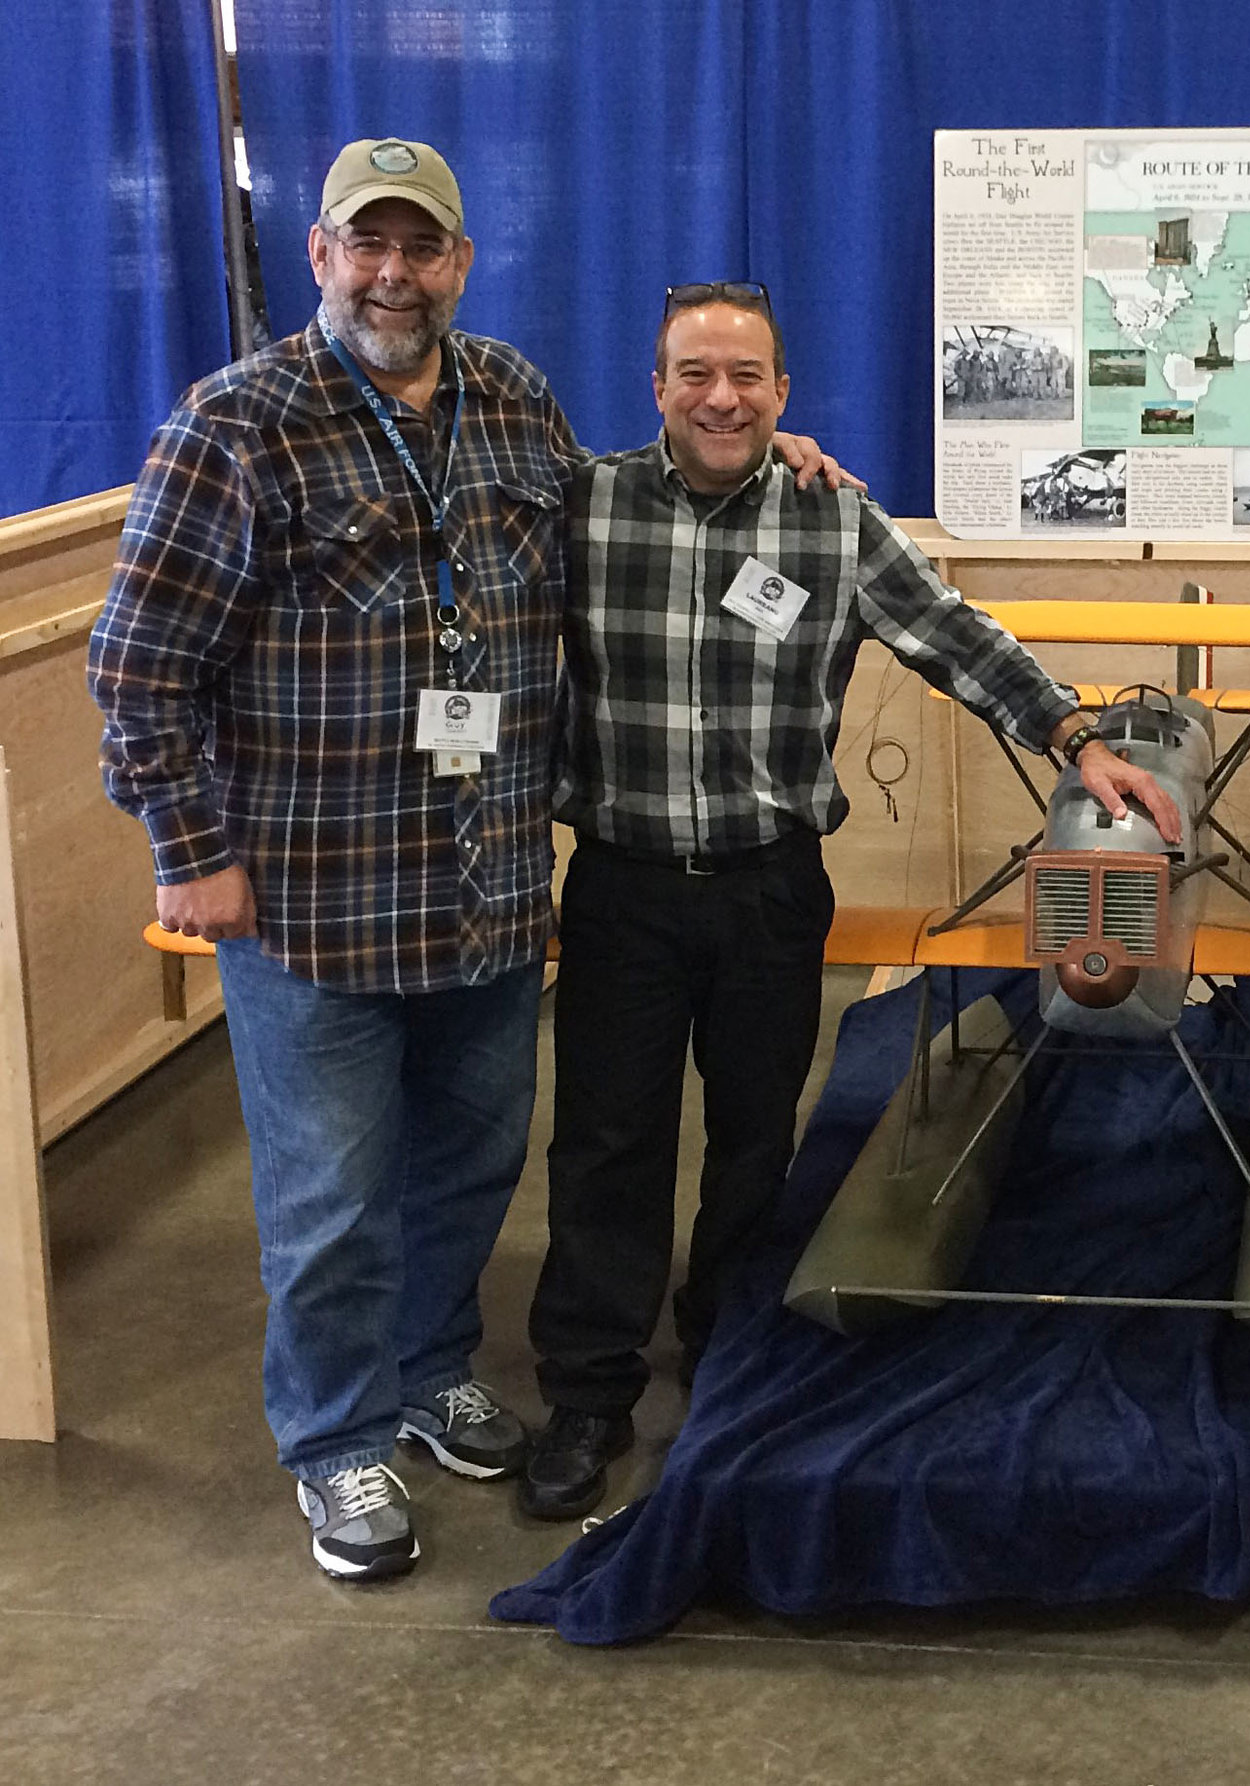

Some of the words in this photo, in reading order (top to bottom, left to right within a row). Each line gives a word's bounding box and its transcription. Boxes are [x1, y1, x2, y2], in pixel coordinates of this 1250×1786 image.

[972, 138, 1006, 155] The
[1015, 138, 1045, 155] First
[1142, 161, 1202, 176] ROUTE
[1206, 161, 1230, 176] OF
[986, 182, 1030, 205] Flight
[361, 385, 381, 413] U.S.
[379, 417, 404, 448] AIR
